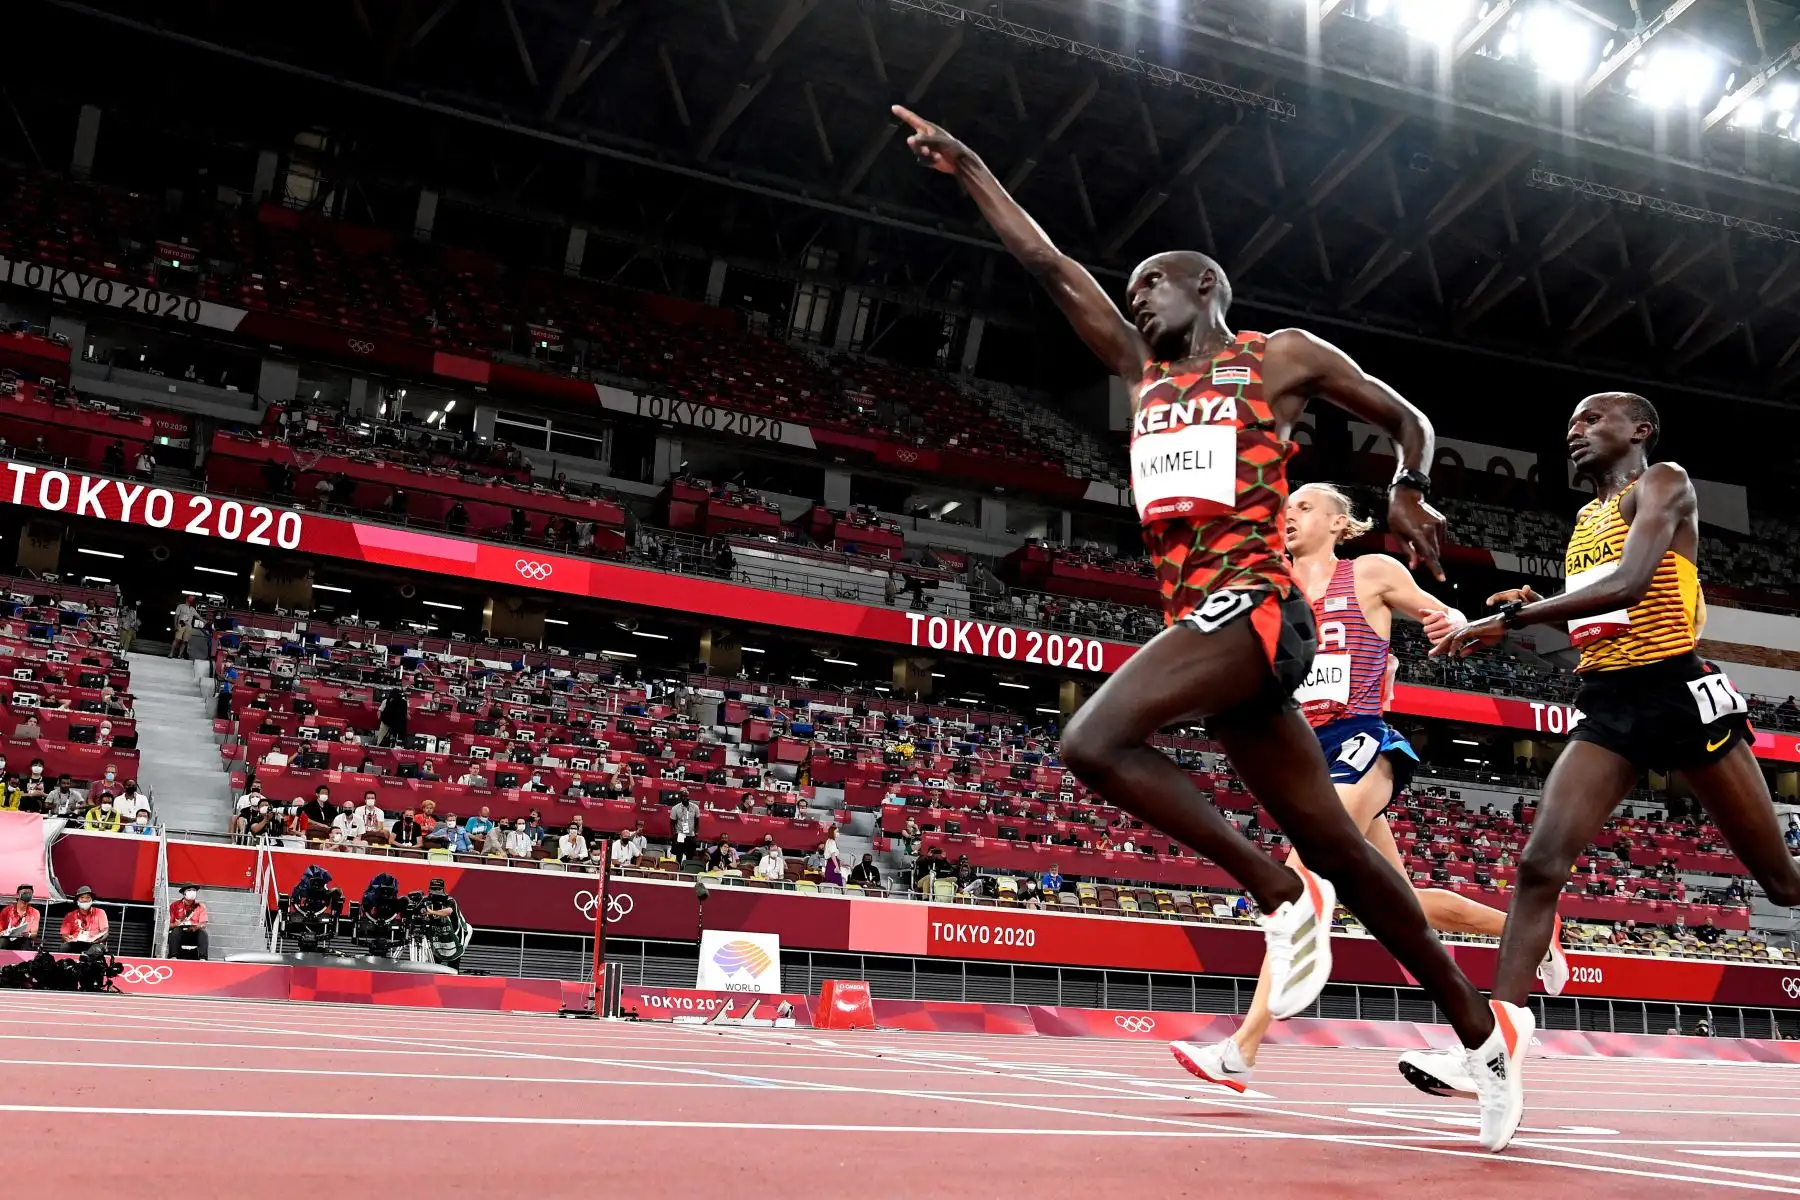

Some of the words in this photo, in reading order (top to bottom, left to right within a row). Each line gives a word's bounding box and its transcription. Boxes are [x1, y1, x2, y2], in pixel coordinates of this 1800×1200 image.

[4, 256, 113, 304] TOKYO
[122, 286, 200, 322] 2020
[633, 391, 716, 429] TOKYO
[723, 410, 782, 442] 2020
[1133, 396, 1237, 438] KENYA
[7, 462, 174, 528] TOKYO
[184, 495, 302, 550] 2020
[1516, 553, 1563, 579] TOKY
[1567, 542, 1614, 573] GANDA
[906, 612, 1017, 659] TOKYO
[1025, 631, 1103, 672] 2020
[1299, 667, 1343, 689] CAID
[1697, 678, 1738, 717] 11
[1530, 702, 1587, 735] TOK
[1348, 735, 1366, 761] 7
[932, 922, 990, 944] TOKYO
[994, 927, 1035, 947] 2020
[725, 983, 761, 992] WORLD
[1571, 966, 1602, 983] 2020
[641, 994, 693, 1009] TOKYO
